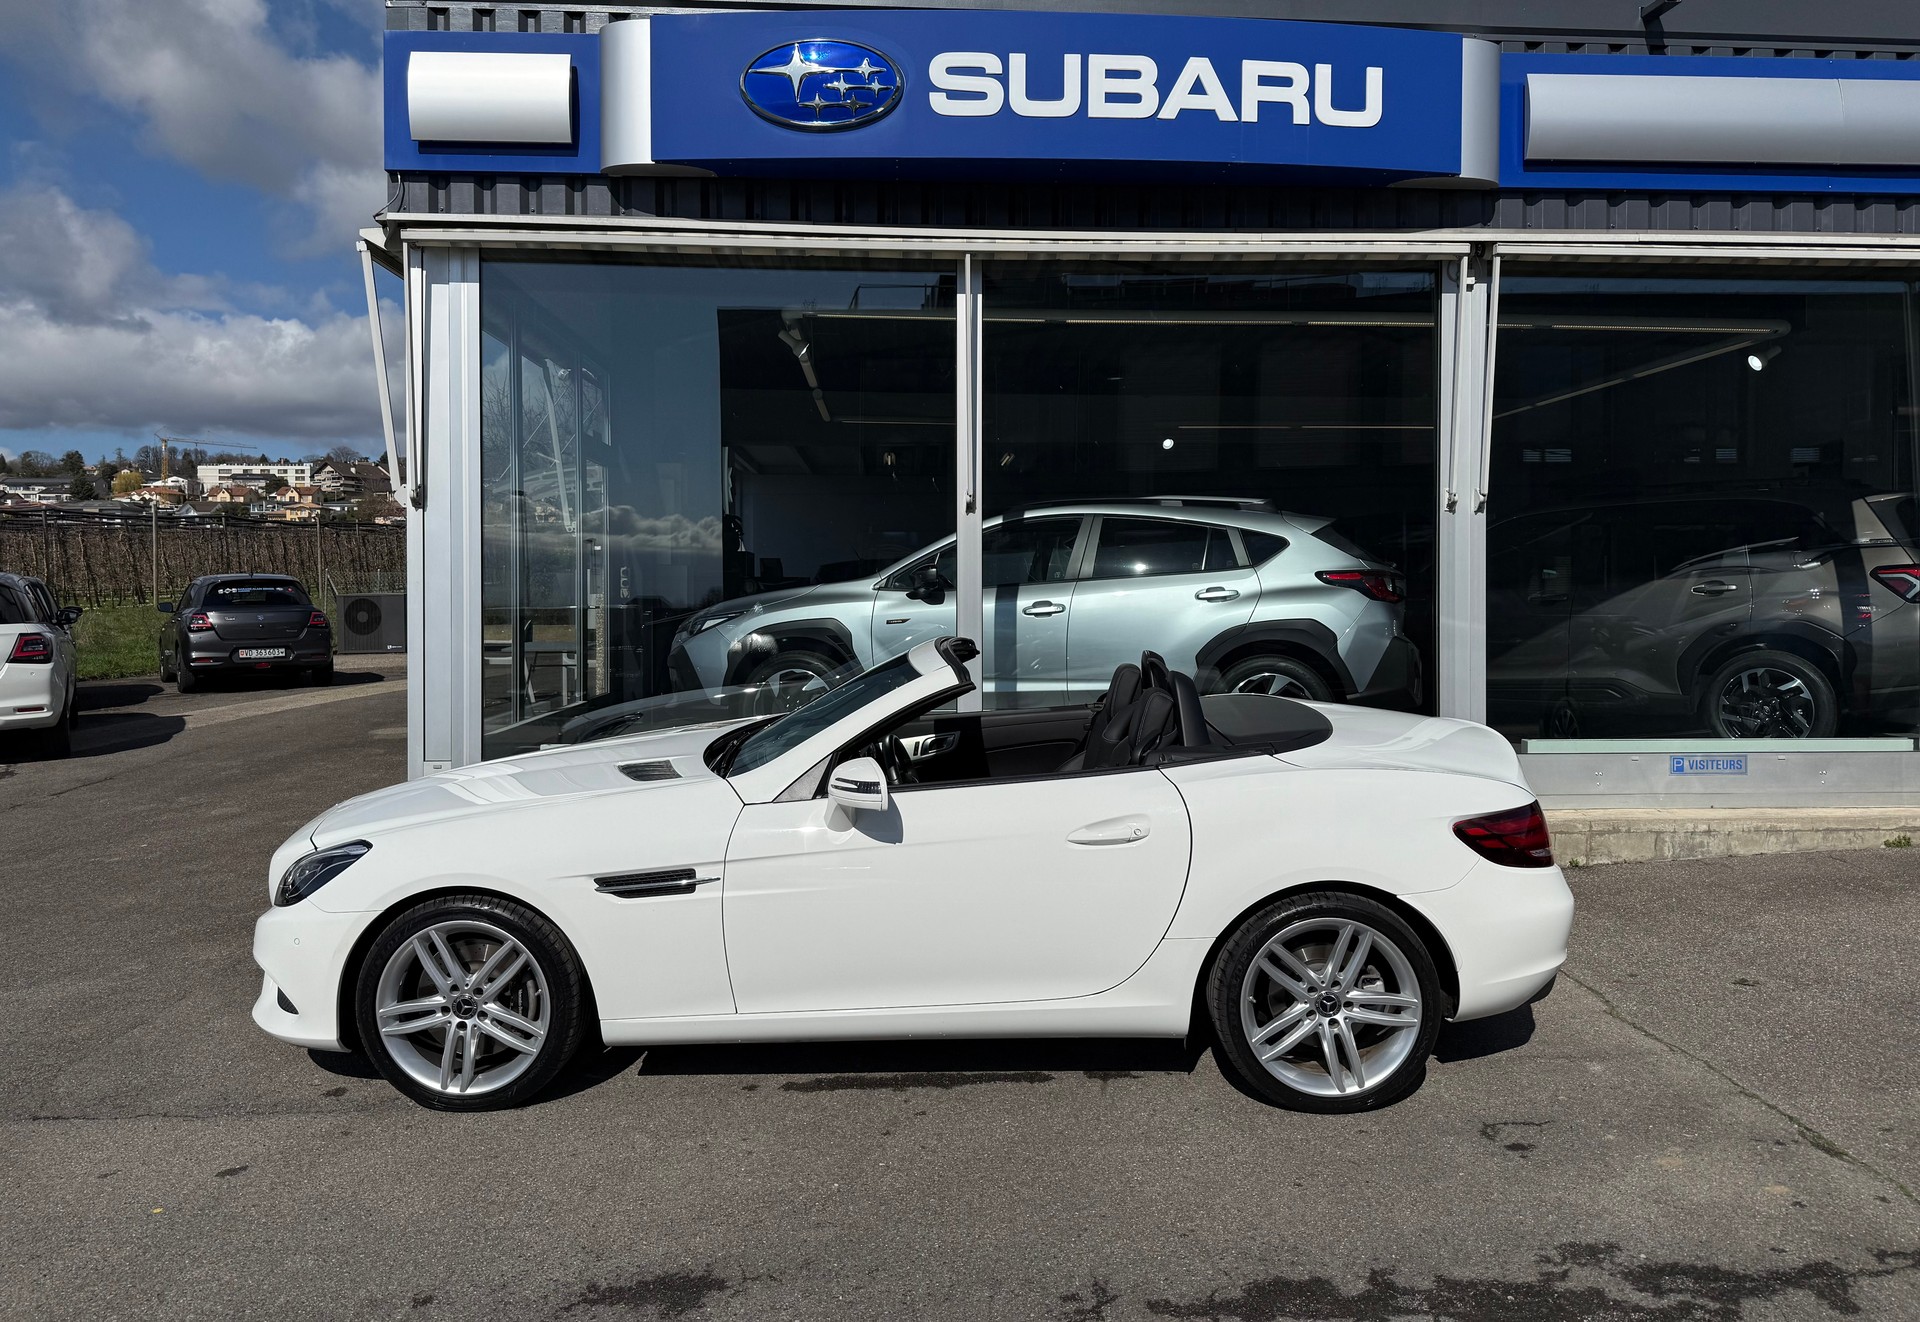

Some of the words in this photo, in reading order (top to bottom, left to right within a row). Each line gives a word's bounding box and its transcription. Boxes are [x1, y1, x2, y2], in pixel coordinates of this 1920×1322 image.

[929, 52, 1383, 127] SUBARU
[245, 649, 253, 657] VD
[1673, 758, 1683, 771] P
[1688, 759, 1743, 770] VISITEURS
